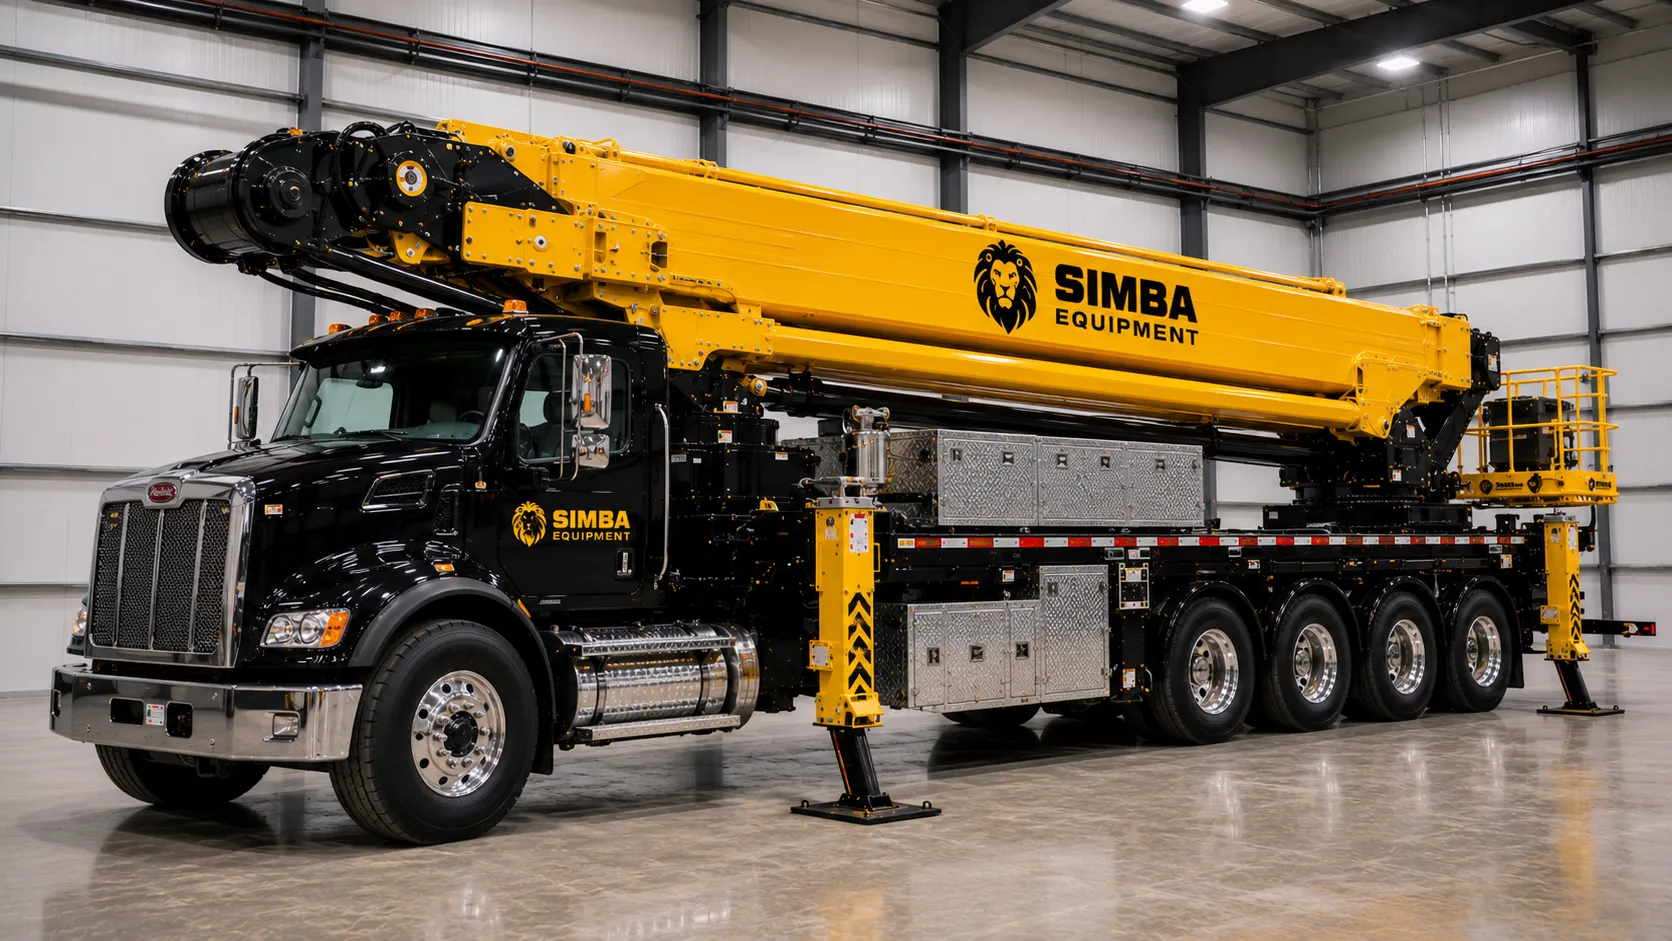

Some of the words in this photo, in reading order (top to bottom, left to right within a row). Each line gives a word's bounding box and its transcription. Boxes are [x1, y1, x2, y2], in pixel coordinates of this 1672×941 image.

[1055, 263, 1198, 323] SIMBA
[1055, 308, 1199, 346] EQUIPMENT
[552, 509, 630, 529] SIMBA
[552, 531, 631, 541] EQUIPMENT
